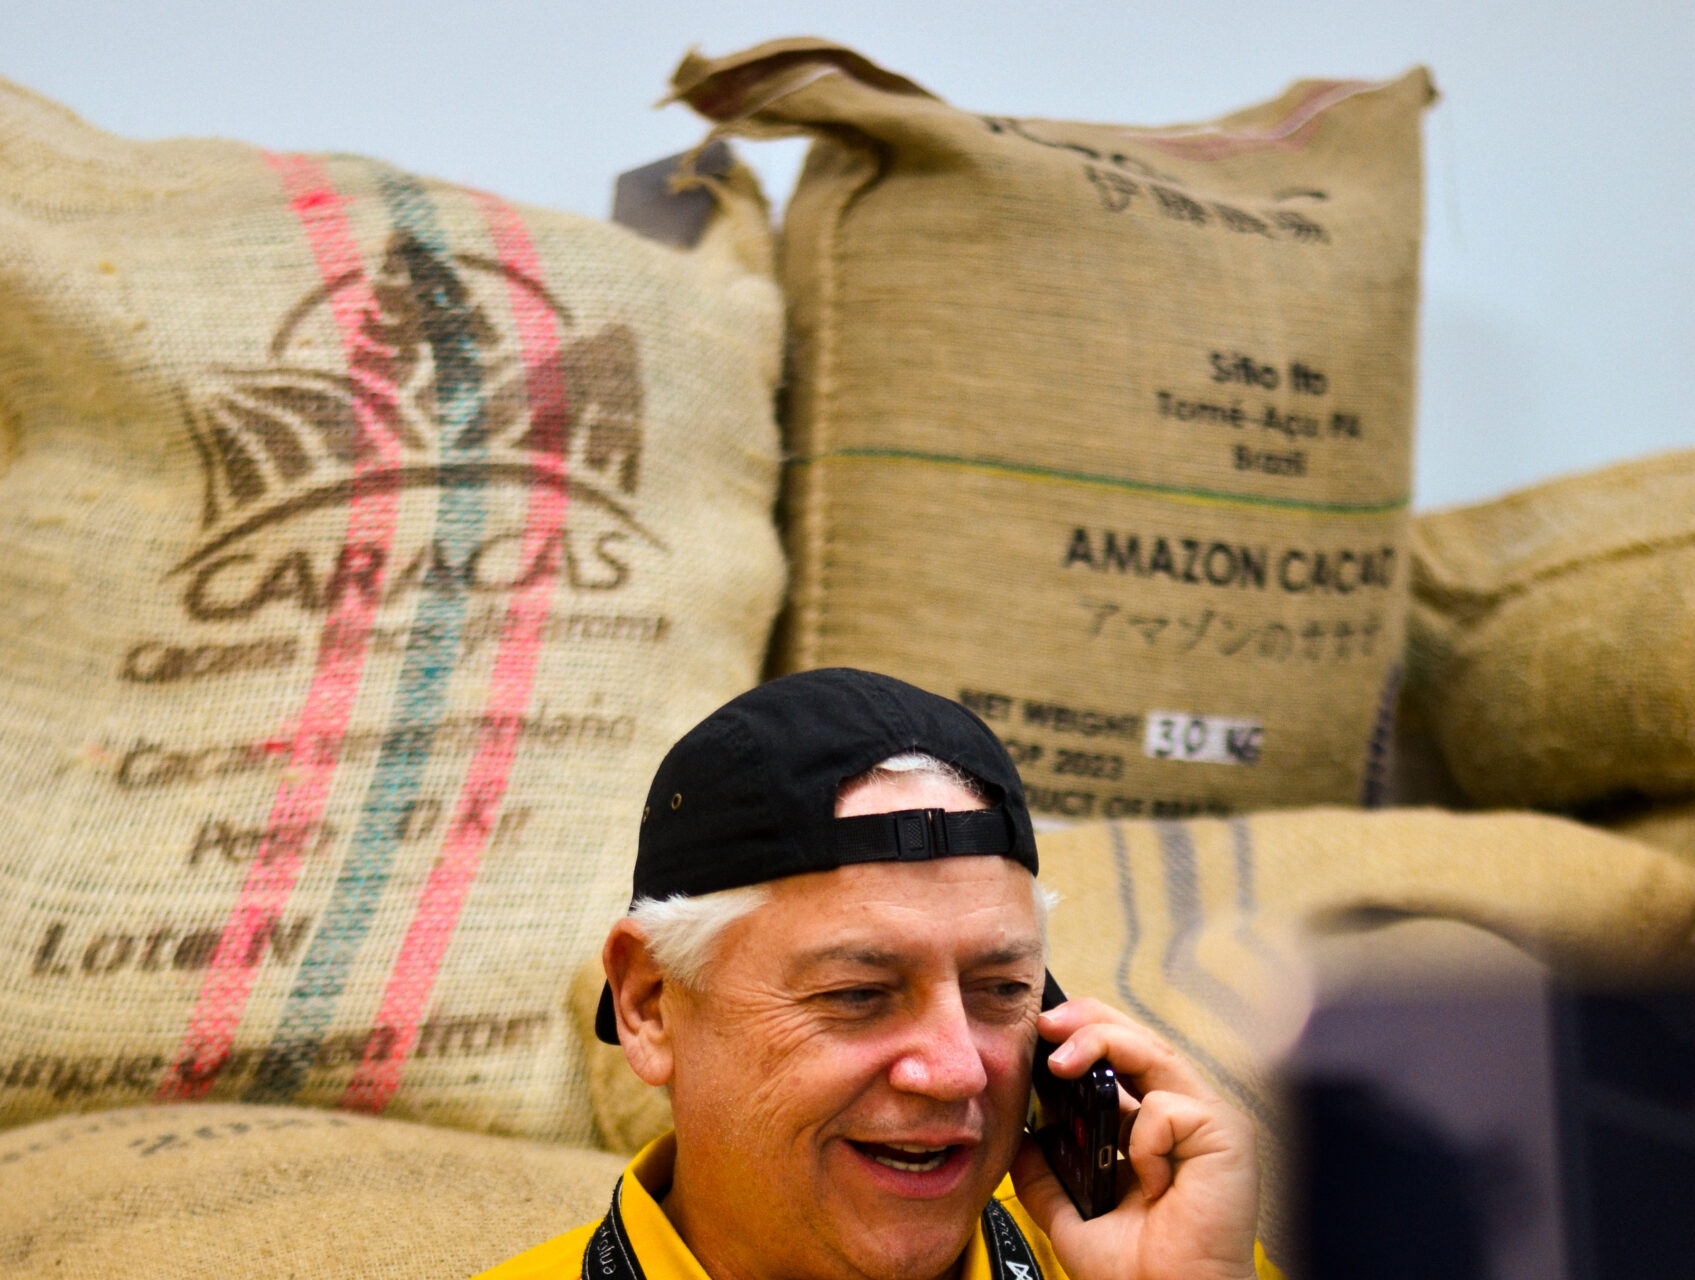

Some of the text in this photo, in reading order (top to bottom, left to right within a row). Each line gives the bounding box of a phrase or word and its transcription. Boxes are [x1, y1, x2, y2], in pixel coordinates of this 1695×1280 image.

[185, 528, 630, 620] CARACAS
[1062, 526, 1267, 591] AMAZON
[1153, 717, 1207, 758] 30
